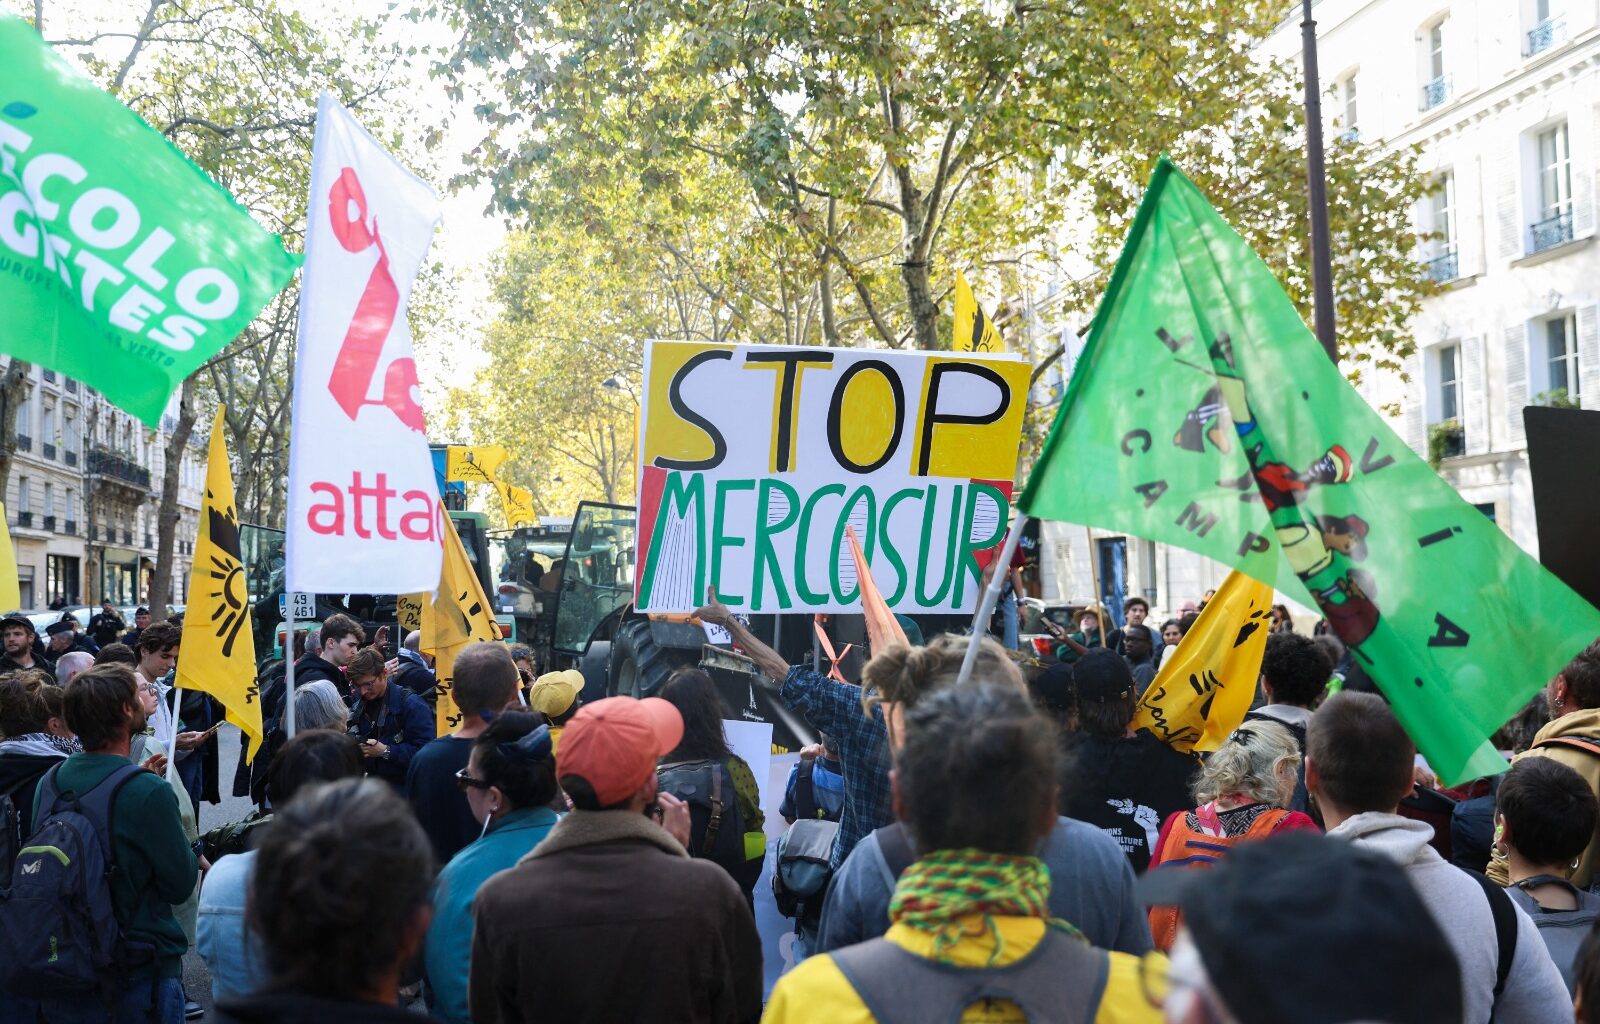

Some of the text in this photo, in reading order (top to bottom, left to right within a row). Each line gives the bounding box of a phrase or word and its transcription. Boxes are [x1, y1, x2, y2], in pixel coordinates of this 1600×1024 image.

[654, 349, 1011, 477] STOP
[307, 471, 445, 549] atta
[637, 471, 1010, 611] MERCOSUR
